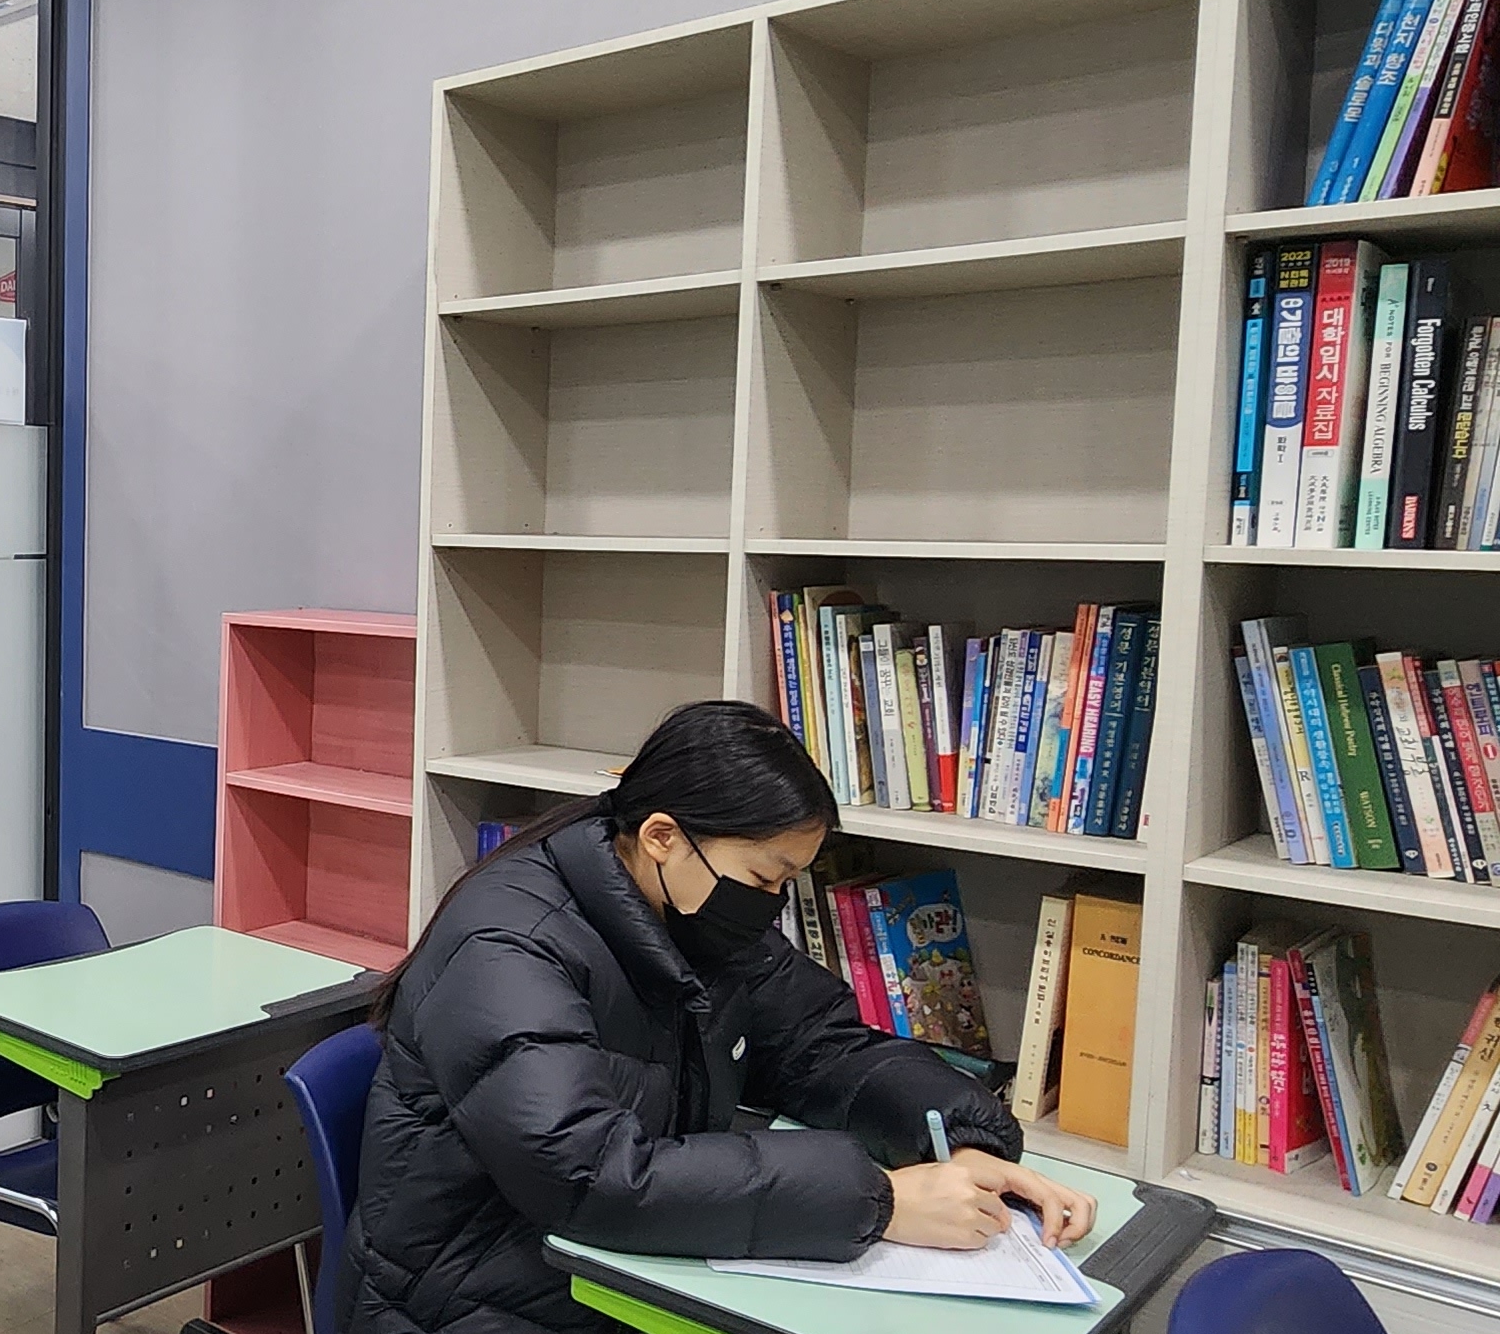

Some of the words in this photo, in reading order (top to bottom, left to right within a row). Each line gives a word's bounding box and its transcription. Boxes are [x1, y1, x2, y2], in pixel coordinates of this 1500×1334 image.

[1391, 11, 1421, 48] 천지
[1281, 251, 1312, 261] 2023
[1316, 307, 1345, 383] 대학입시
[1385, 309, 1395, 336] NOTES
[1384, 341, 1392, 358] FOR
[1408, 316, 1441, 377] Forgotten
[1313, 386, 1338, 440] 자료집
[1374, 362, 1392, 422] BEGINNING
[1407, 378, 1435, 431] Calculus
[1369, 424, 1385, 475] ALGEBRA
[876, 638, 890, 666] 그들이
[881, 698, 894, 717] 교회
[1086, 679, 1102, 707] EASY
[1079, 708, 1098, 753] HEARING
[1328, 662, 1348, 699] Classical
[1341, 728, 1360, 758] Poetry
[1358, 790, 1377, 829] WATSON
